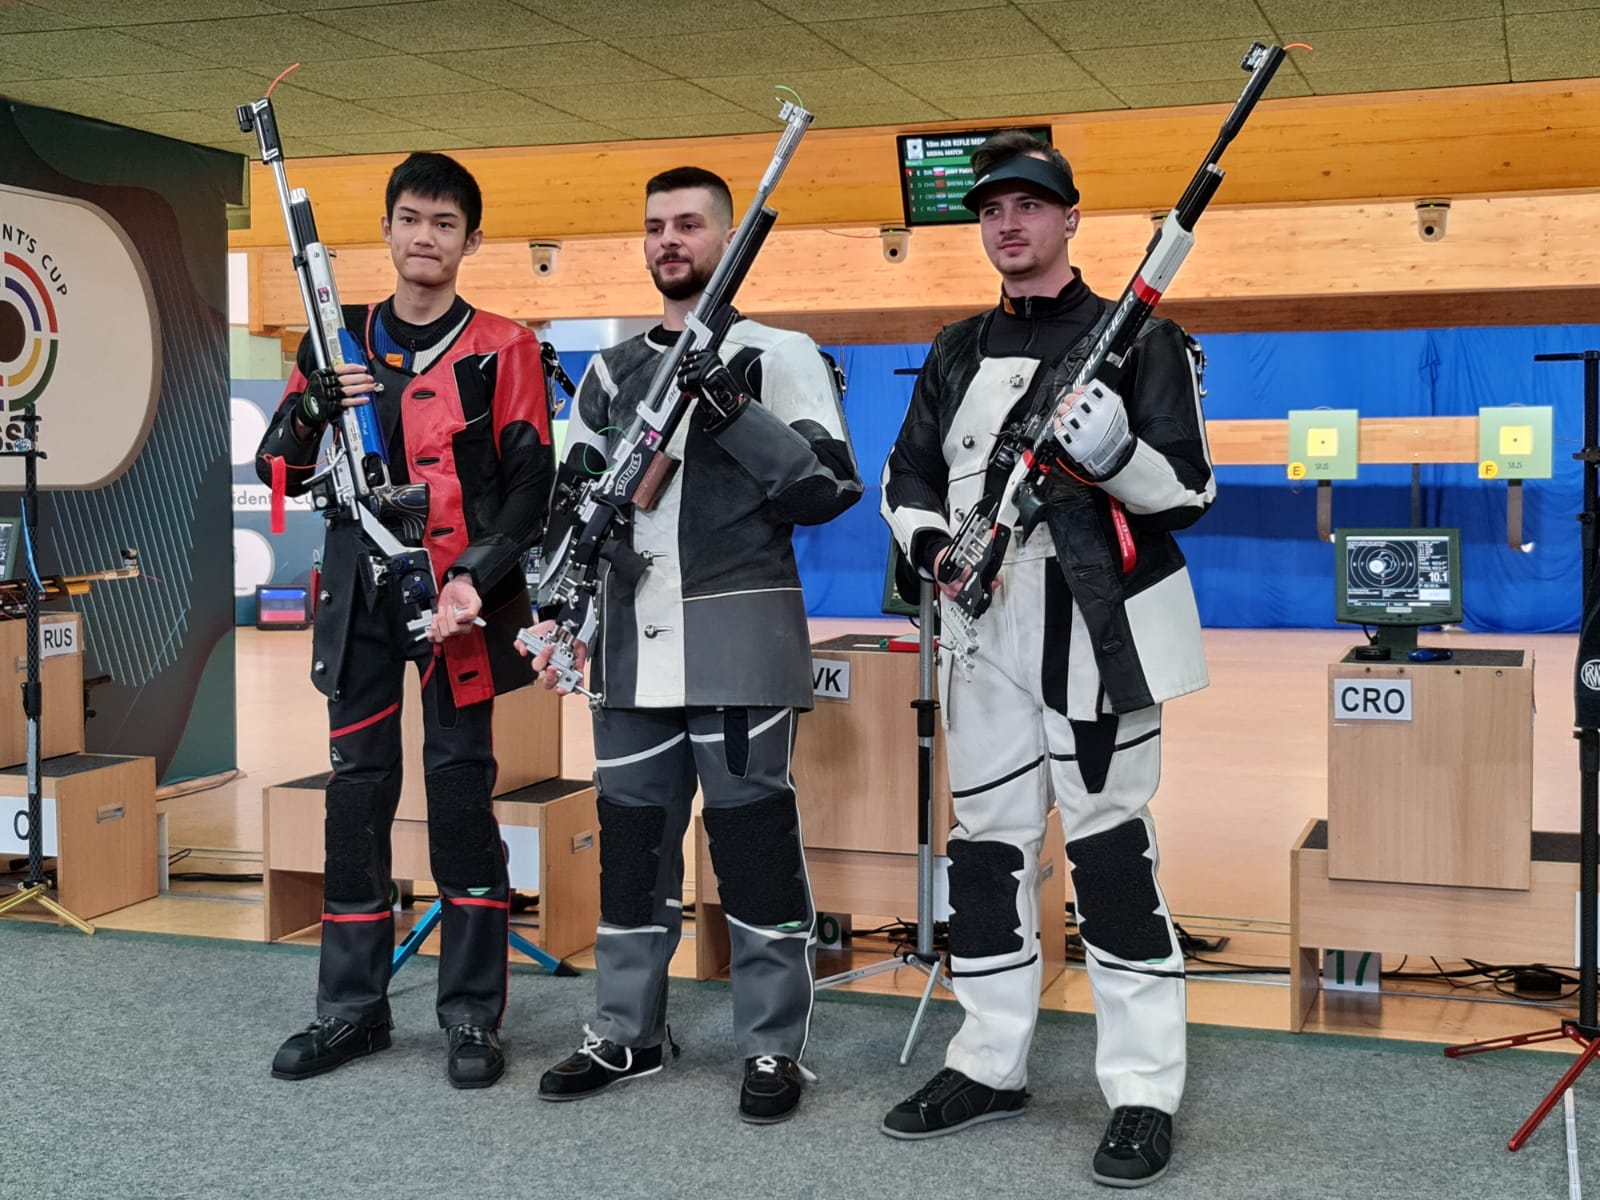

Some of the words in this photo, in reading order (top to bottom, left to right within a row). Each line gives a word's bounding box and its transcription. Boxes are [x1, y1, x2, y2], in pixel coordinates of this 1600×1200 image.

[41, 254, 68, 296] CUP
[1292, 465, 1301, 476] E
[1485, 464, 1493, 475] F
[1428, 571, 1448, 583] 10.1
[44, 627, 73, 649] RUS
[1341, 686, 1405, 714] CRO
